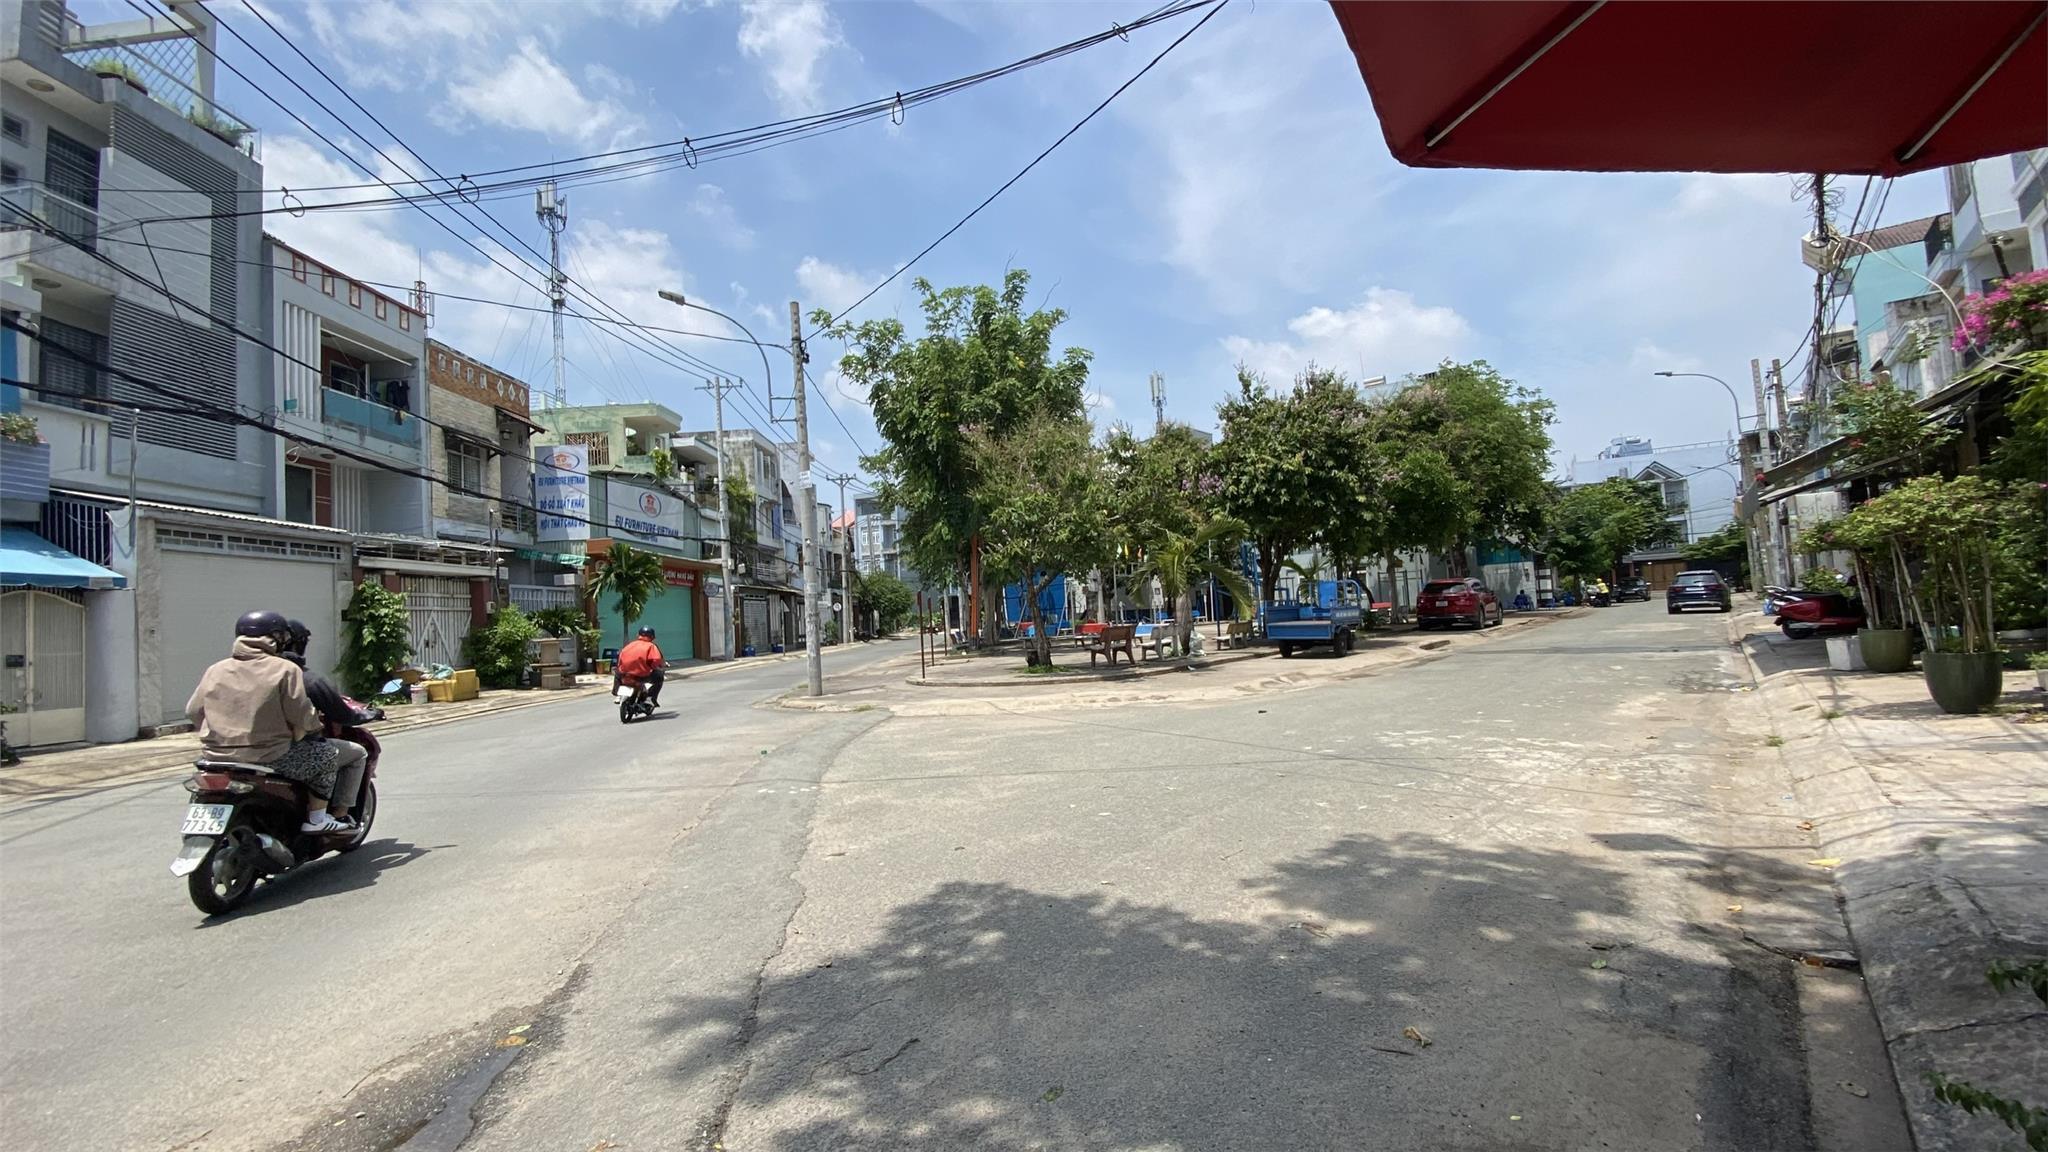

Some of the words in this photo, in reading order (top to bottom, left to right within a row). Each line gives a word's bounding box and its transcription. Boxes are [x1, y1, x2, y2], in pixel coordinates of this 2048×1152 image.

[567, 476, 586, 484] VIETNAM
[615, 514, 624, 528] EU
[625, 518, 656, 533] FURNITURE
[656, 525, 679, 537] VIETNAM
[182, 820, 224, 832] 773.45
